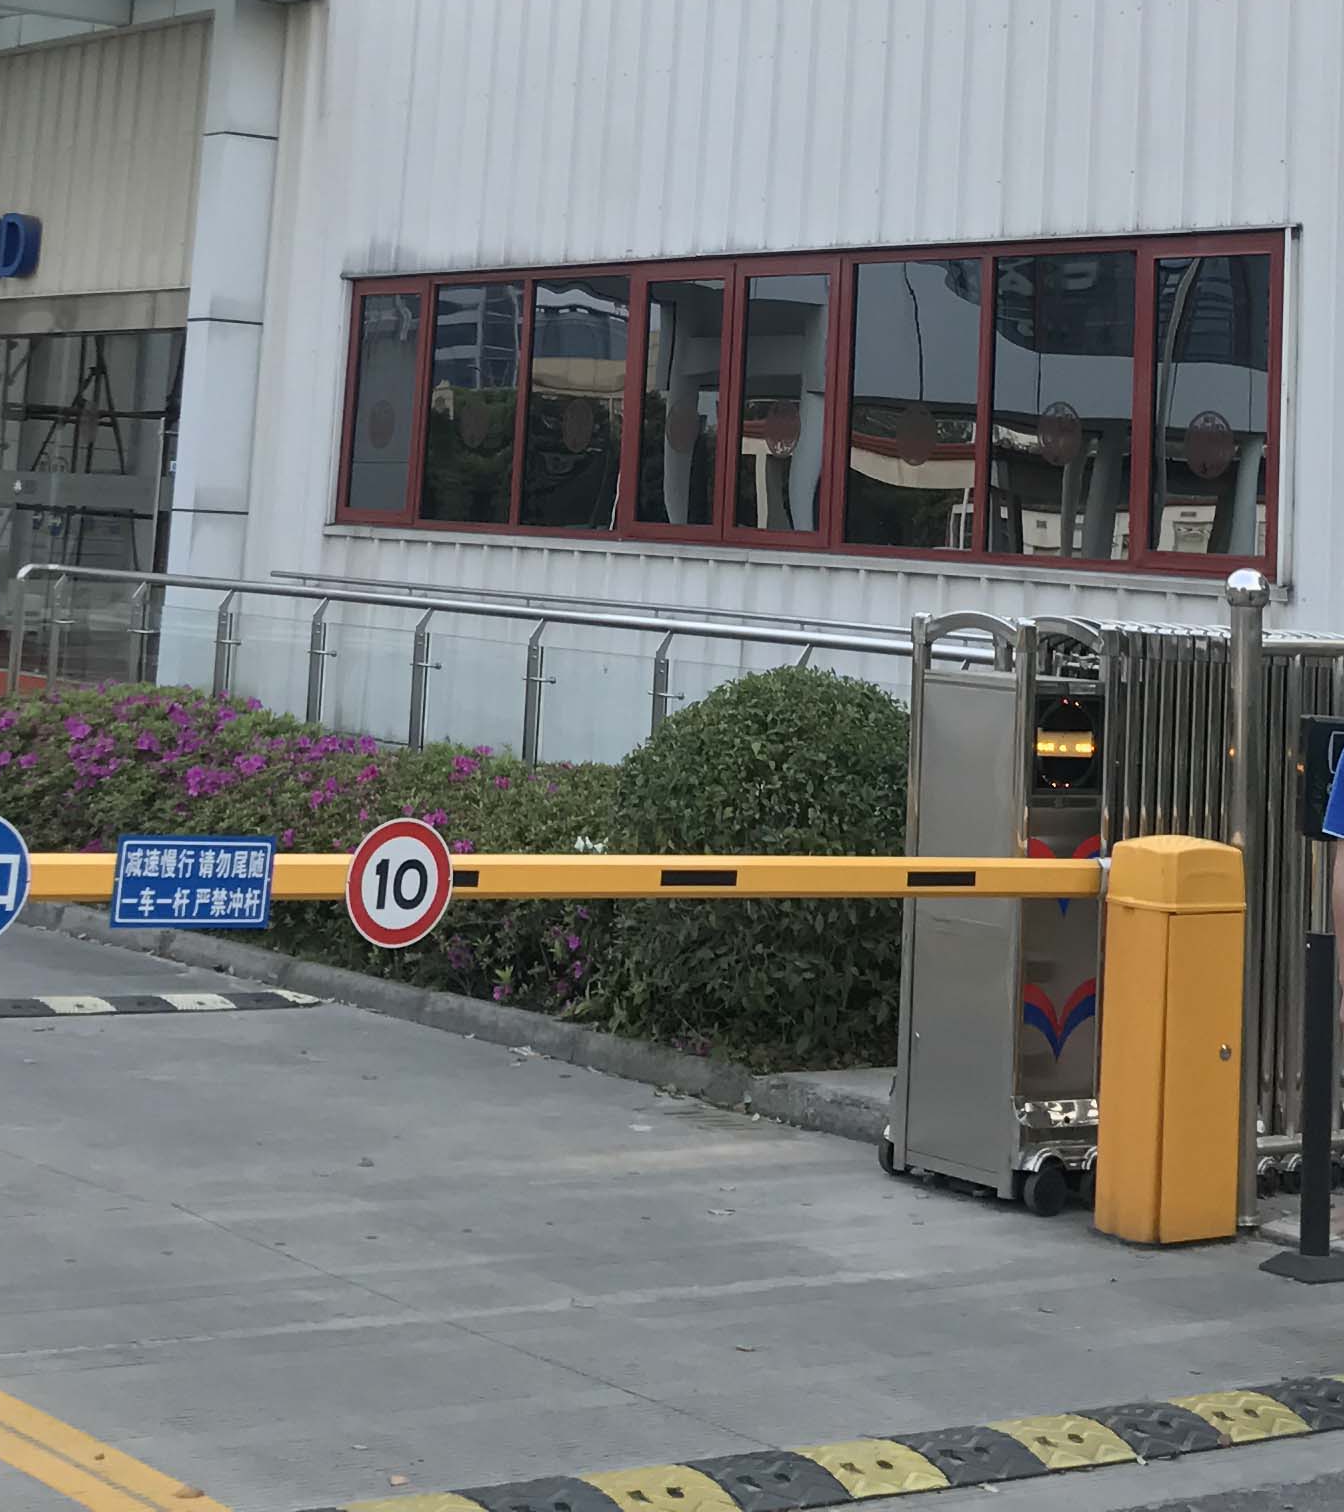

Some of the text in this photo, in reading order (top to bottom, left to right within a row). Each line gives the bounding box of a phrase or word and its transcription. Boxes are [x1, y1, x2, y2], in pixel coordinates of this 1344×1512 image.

[125, 848, 266, 879] 减速慢行 请勿尾随
[375, 858, 428, 911] 10
[122, 887, 262, 918] 一车一杆 严禁冲杆
